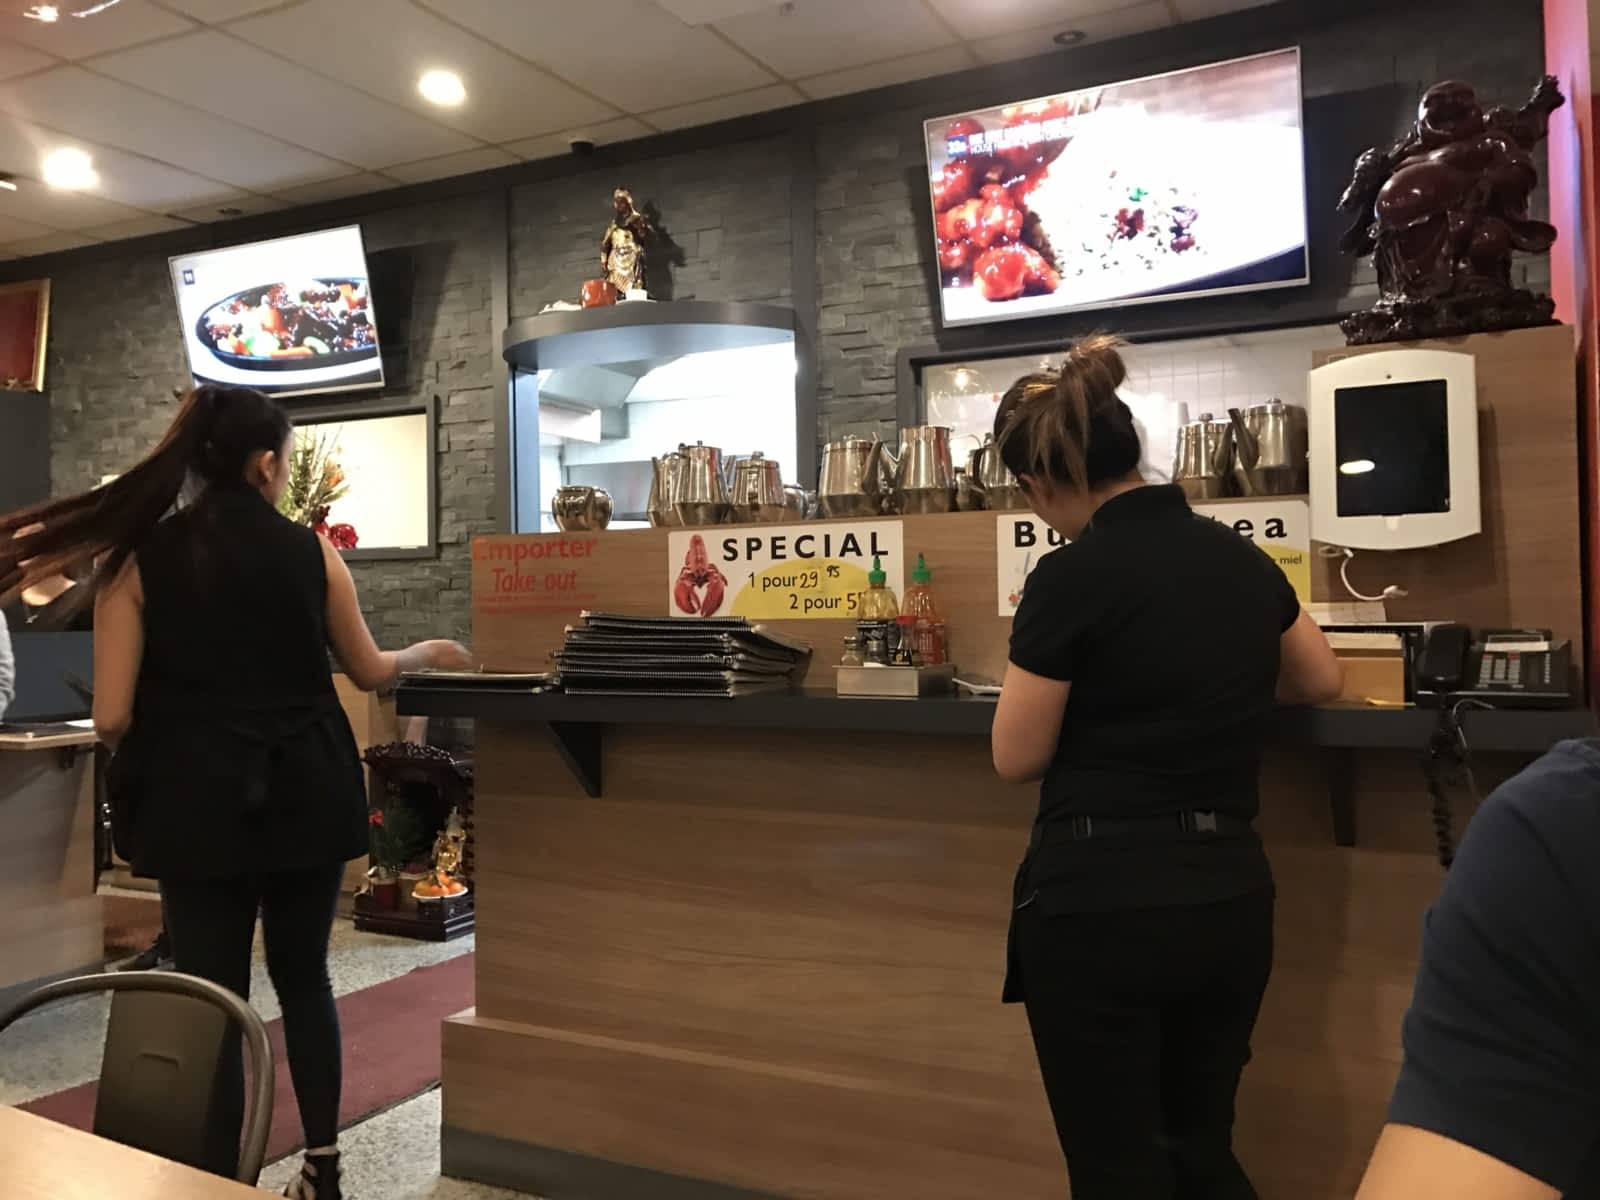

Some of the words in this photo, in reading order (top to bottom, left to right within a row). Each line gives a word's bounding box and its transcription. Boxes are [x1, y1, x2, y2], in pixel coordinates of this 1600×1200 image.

[722, 532, 889, 561] SPECIAL
[1279, 554, 1302, 565] miel
[492, 567, 536, 592] Take
[544, 569, 577, 591] out
[748, 571, 755, 588] 1
[762, 575, 798, 592] pour
[799, 572, 818, 588] 29
[789, 593, 799, 609] 2
[804, 595, 842, 613] pour
